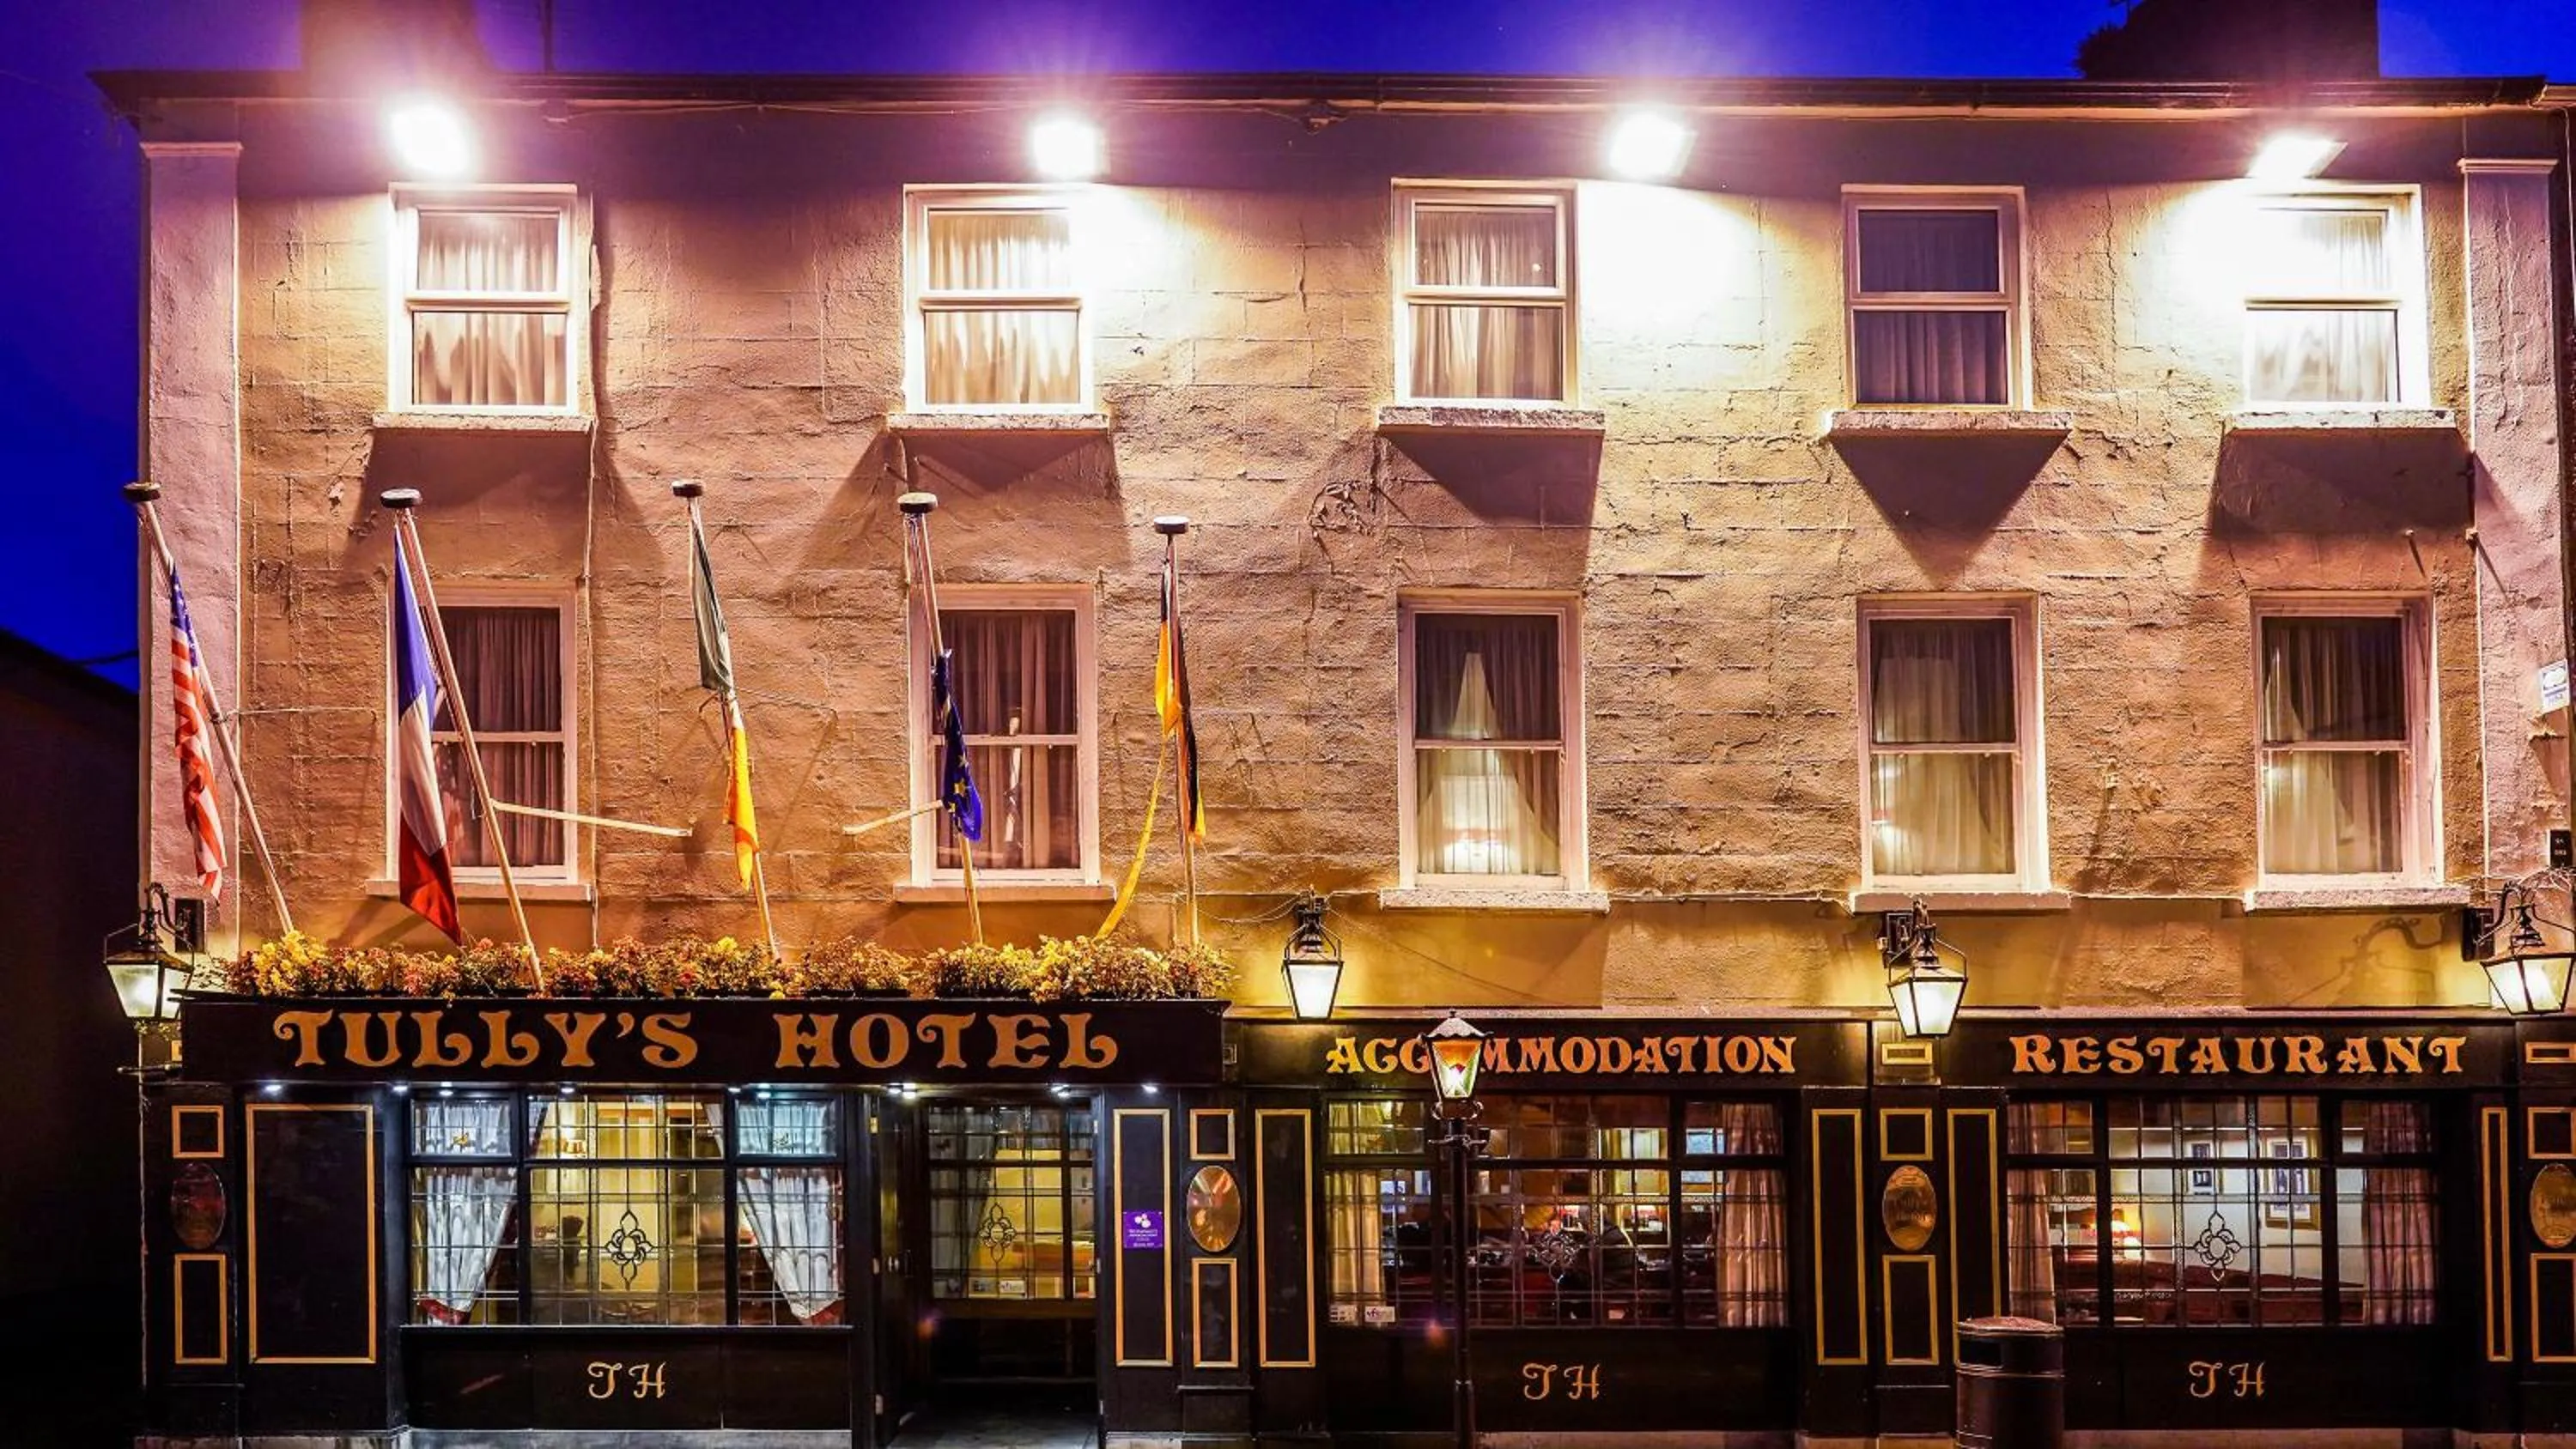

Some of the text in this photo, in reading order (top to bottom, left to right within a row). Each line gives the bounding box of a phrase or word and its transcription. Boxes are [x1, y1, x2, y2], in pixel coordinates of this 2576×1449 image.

[274, 1010, 1118, 1069] TULLY'S HOTEL
[1326, 1036, 1796, 1074] ACCMMODATION
[2009, 1035, 2467, 1075] RESTAURANT
